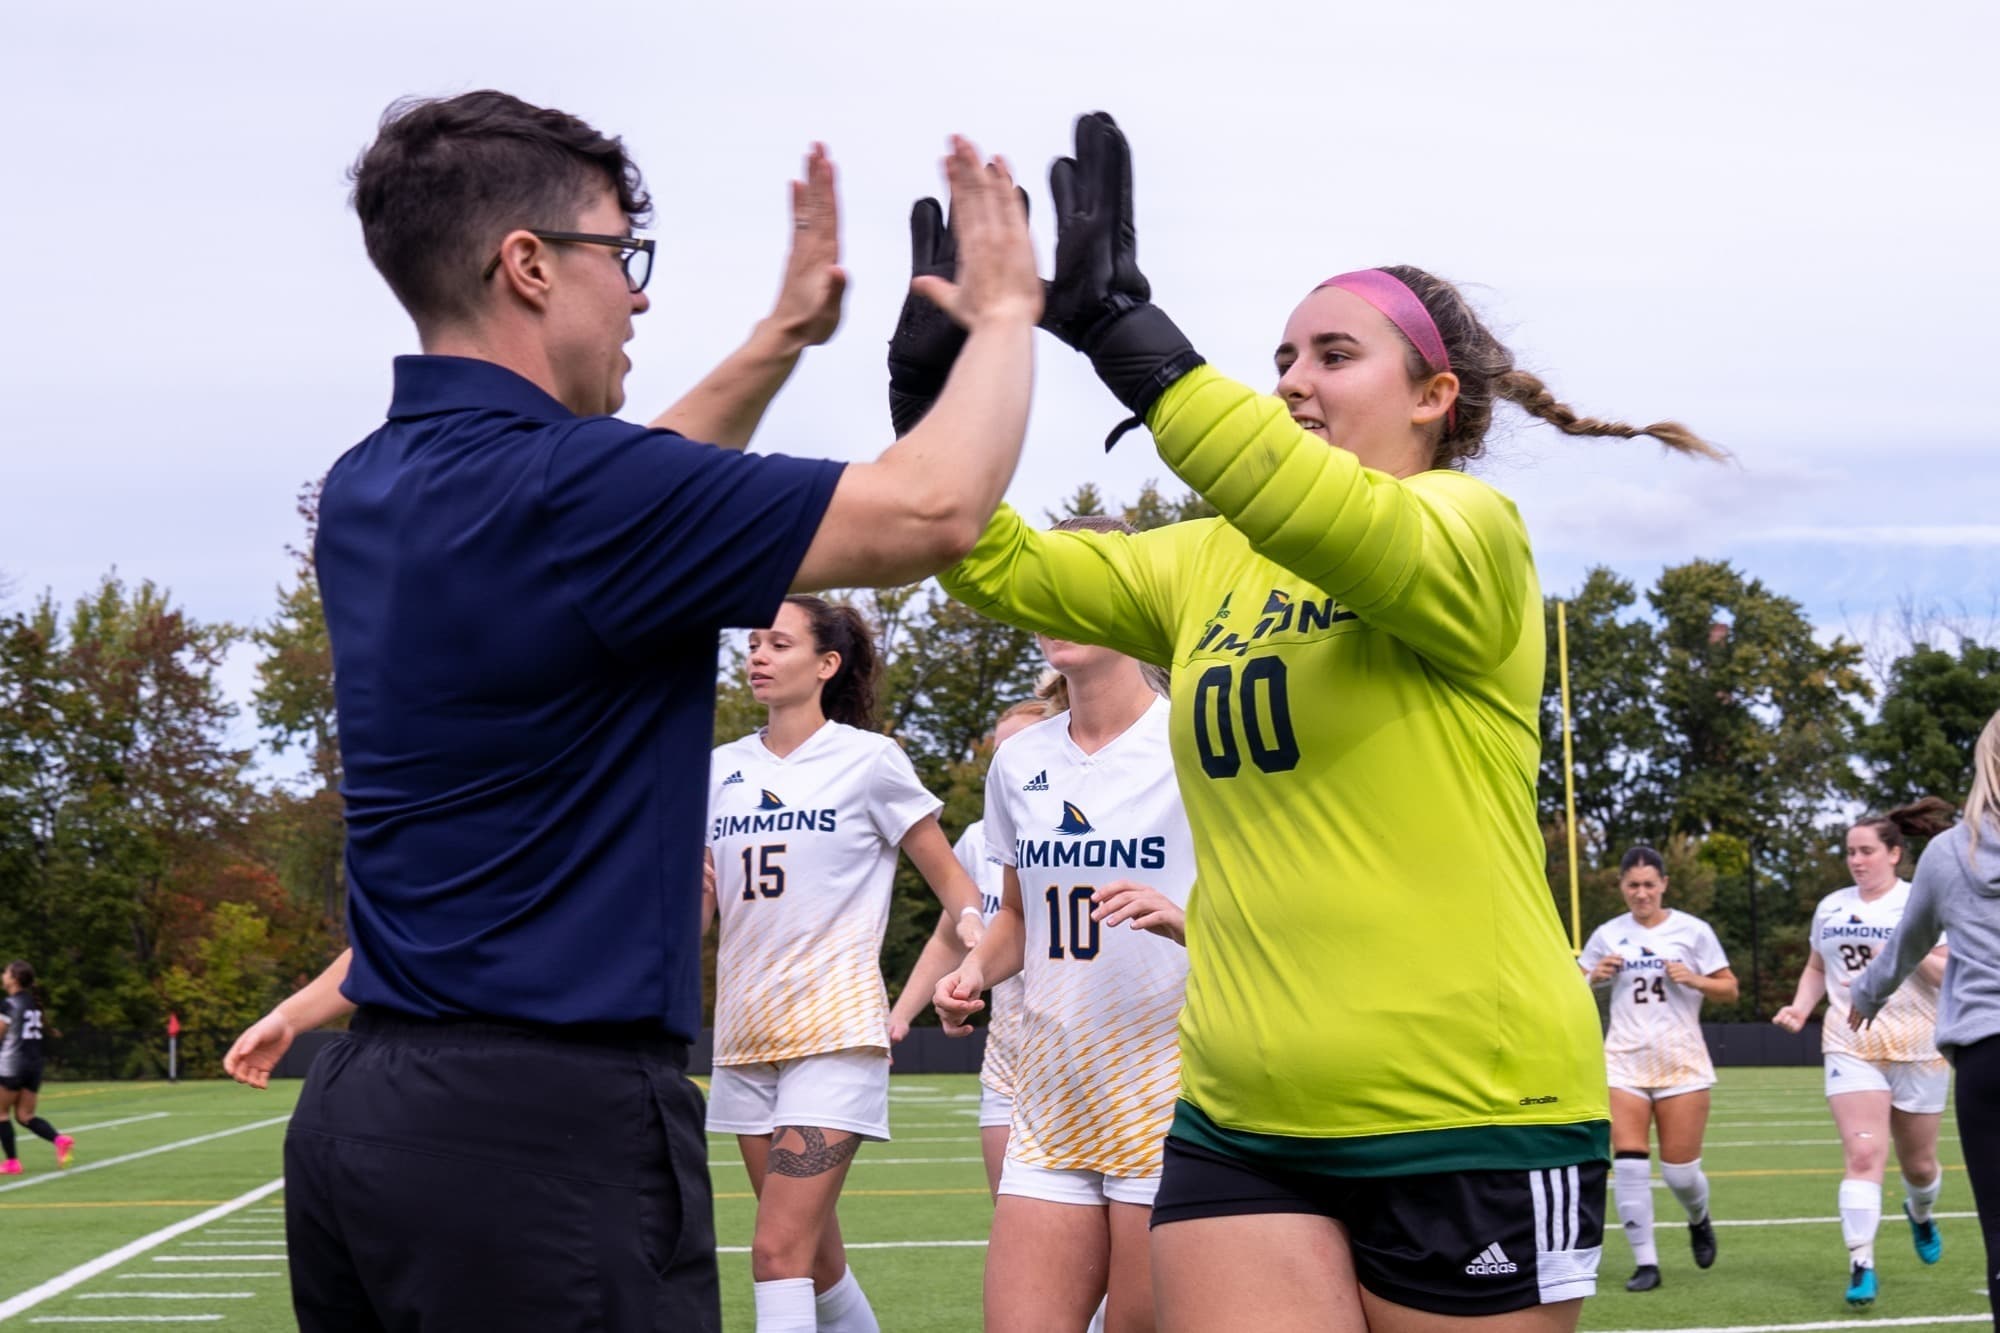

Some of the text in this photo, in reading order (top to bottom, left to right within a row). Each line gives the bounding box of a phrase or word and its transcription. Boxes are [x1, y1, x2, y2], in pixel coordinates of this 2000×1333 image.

[1194, 655, 1300, 780] 00
[741, 843, 787, 901] 15
[1045, 884, 1100, 961] 10
[1633, 976, 1667, 1004] 24
[1465, 1261, 1518, 1275] adidas
